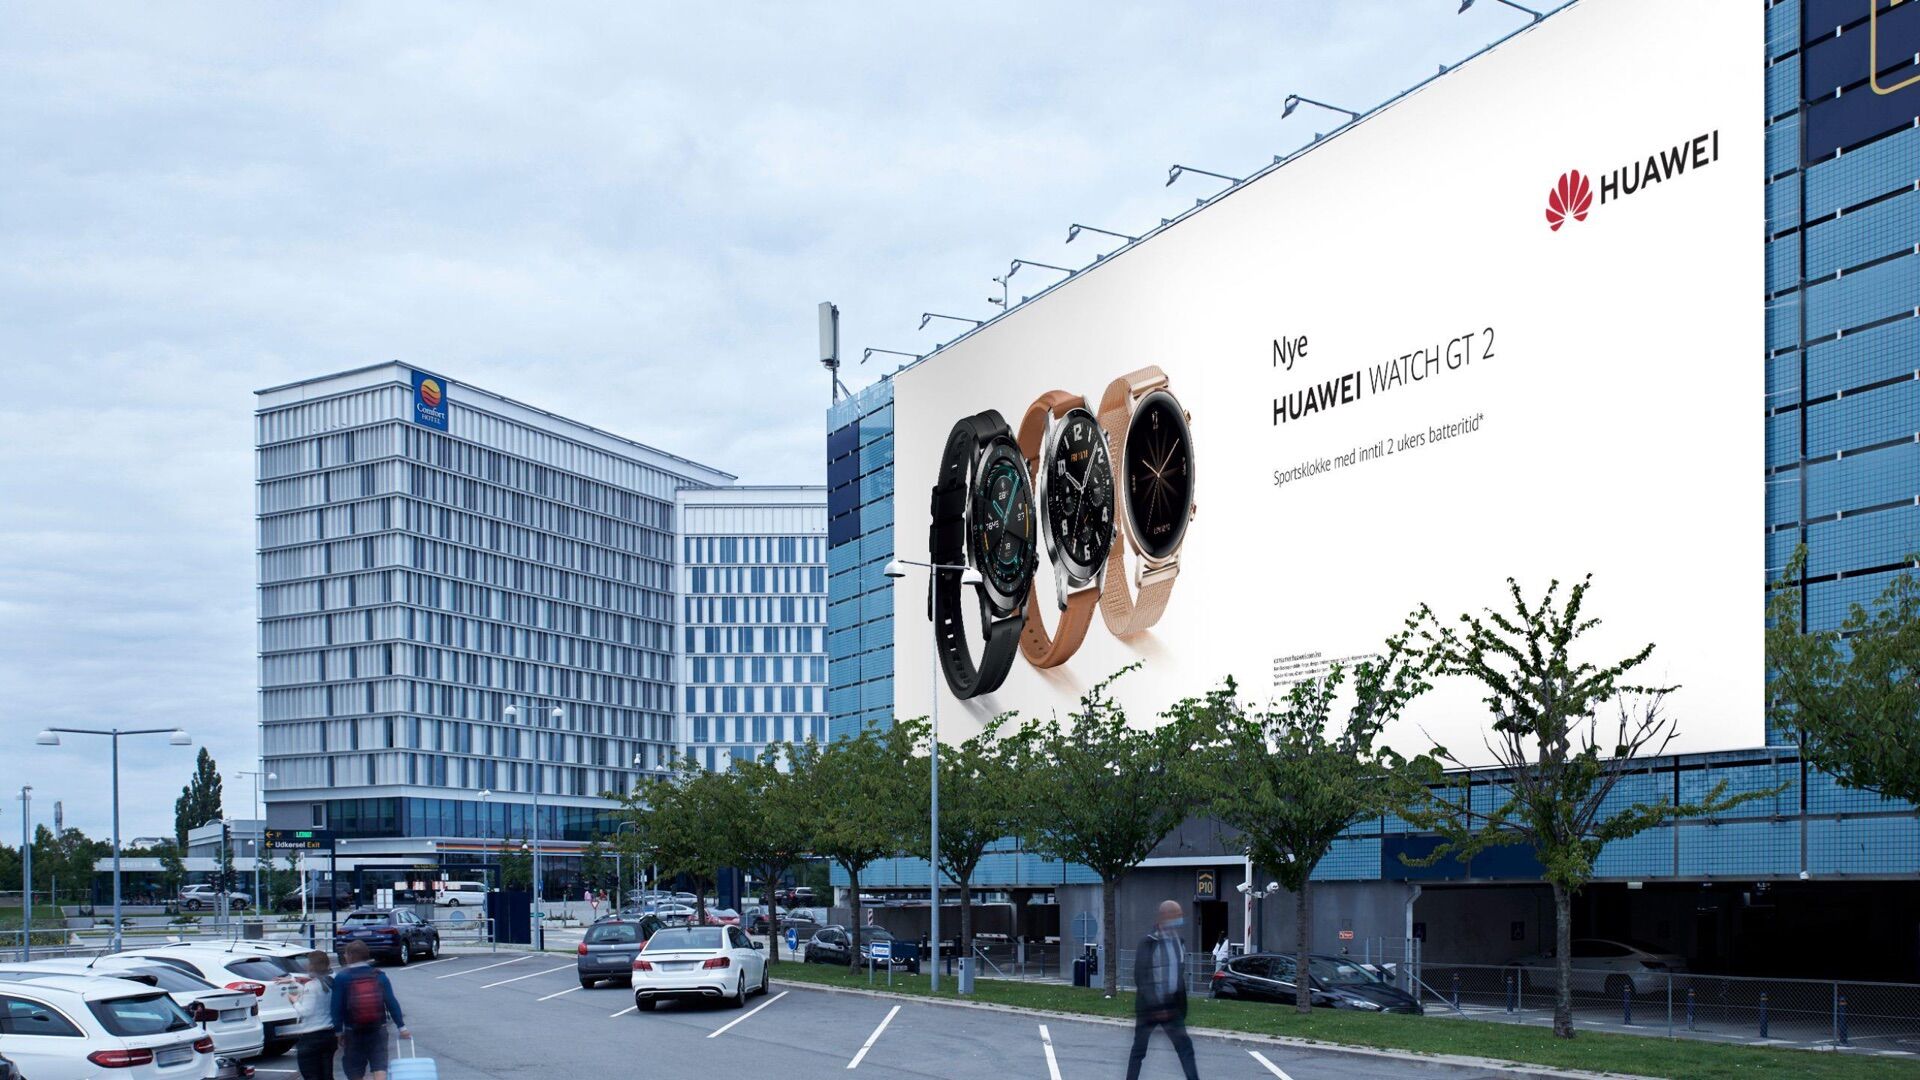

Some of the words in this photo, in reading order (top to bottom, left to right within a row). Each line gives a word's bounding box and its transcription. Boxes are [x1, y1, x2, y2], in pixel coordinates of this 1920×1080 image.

[1601, 129, 1719, 205] HUAWEI
[1273, 335, 1308, 371] Nye
[1273, 370, 1361, 426] HUAWEI
[1368, 344, 1440, 395] WATCH
[1446, 333, 1475, 370] GT
[1482, 327, 1495, 360] 2
[417, 402, 445, 420] Comfort
[422, 414, 441, 424] HOTEL
[1273, 456, 1331, 488] Sportsklokke
[1334, 449, 1356, 469] med
[1359, 440, 1384, 463] inntil
[1387, 438, 1394, 456] 2
[1397, 432, 1426, 453] ukers
[306, 841, 320, 849] Exit
[1198, 881, 1212, 893] P10
